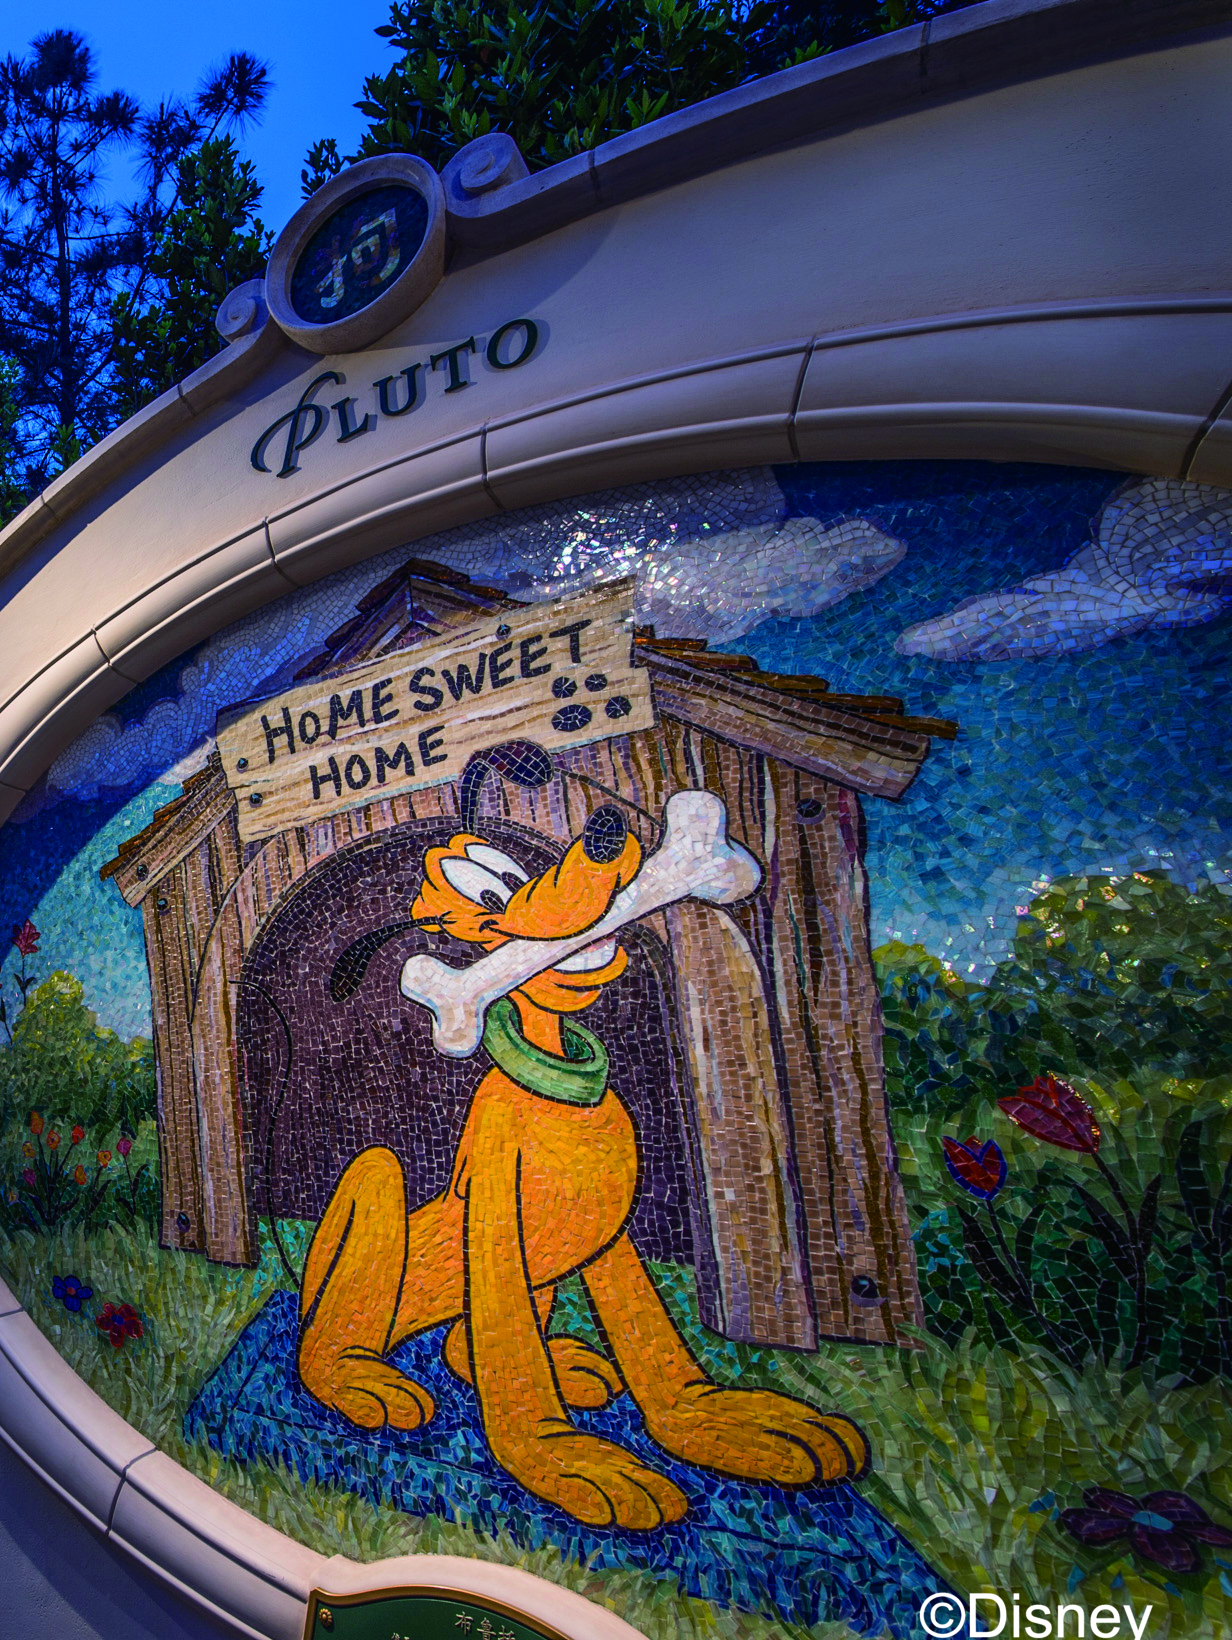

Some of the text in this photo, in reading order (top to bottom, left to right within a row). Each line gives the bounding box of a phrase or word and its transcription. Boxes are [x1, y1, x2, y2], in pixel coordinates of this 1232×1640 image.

[249, 318, 539, 479] PLUTO
[260, 618, 593, 764] HOME SWEET
[309, 725, 448, 800] HOME
